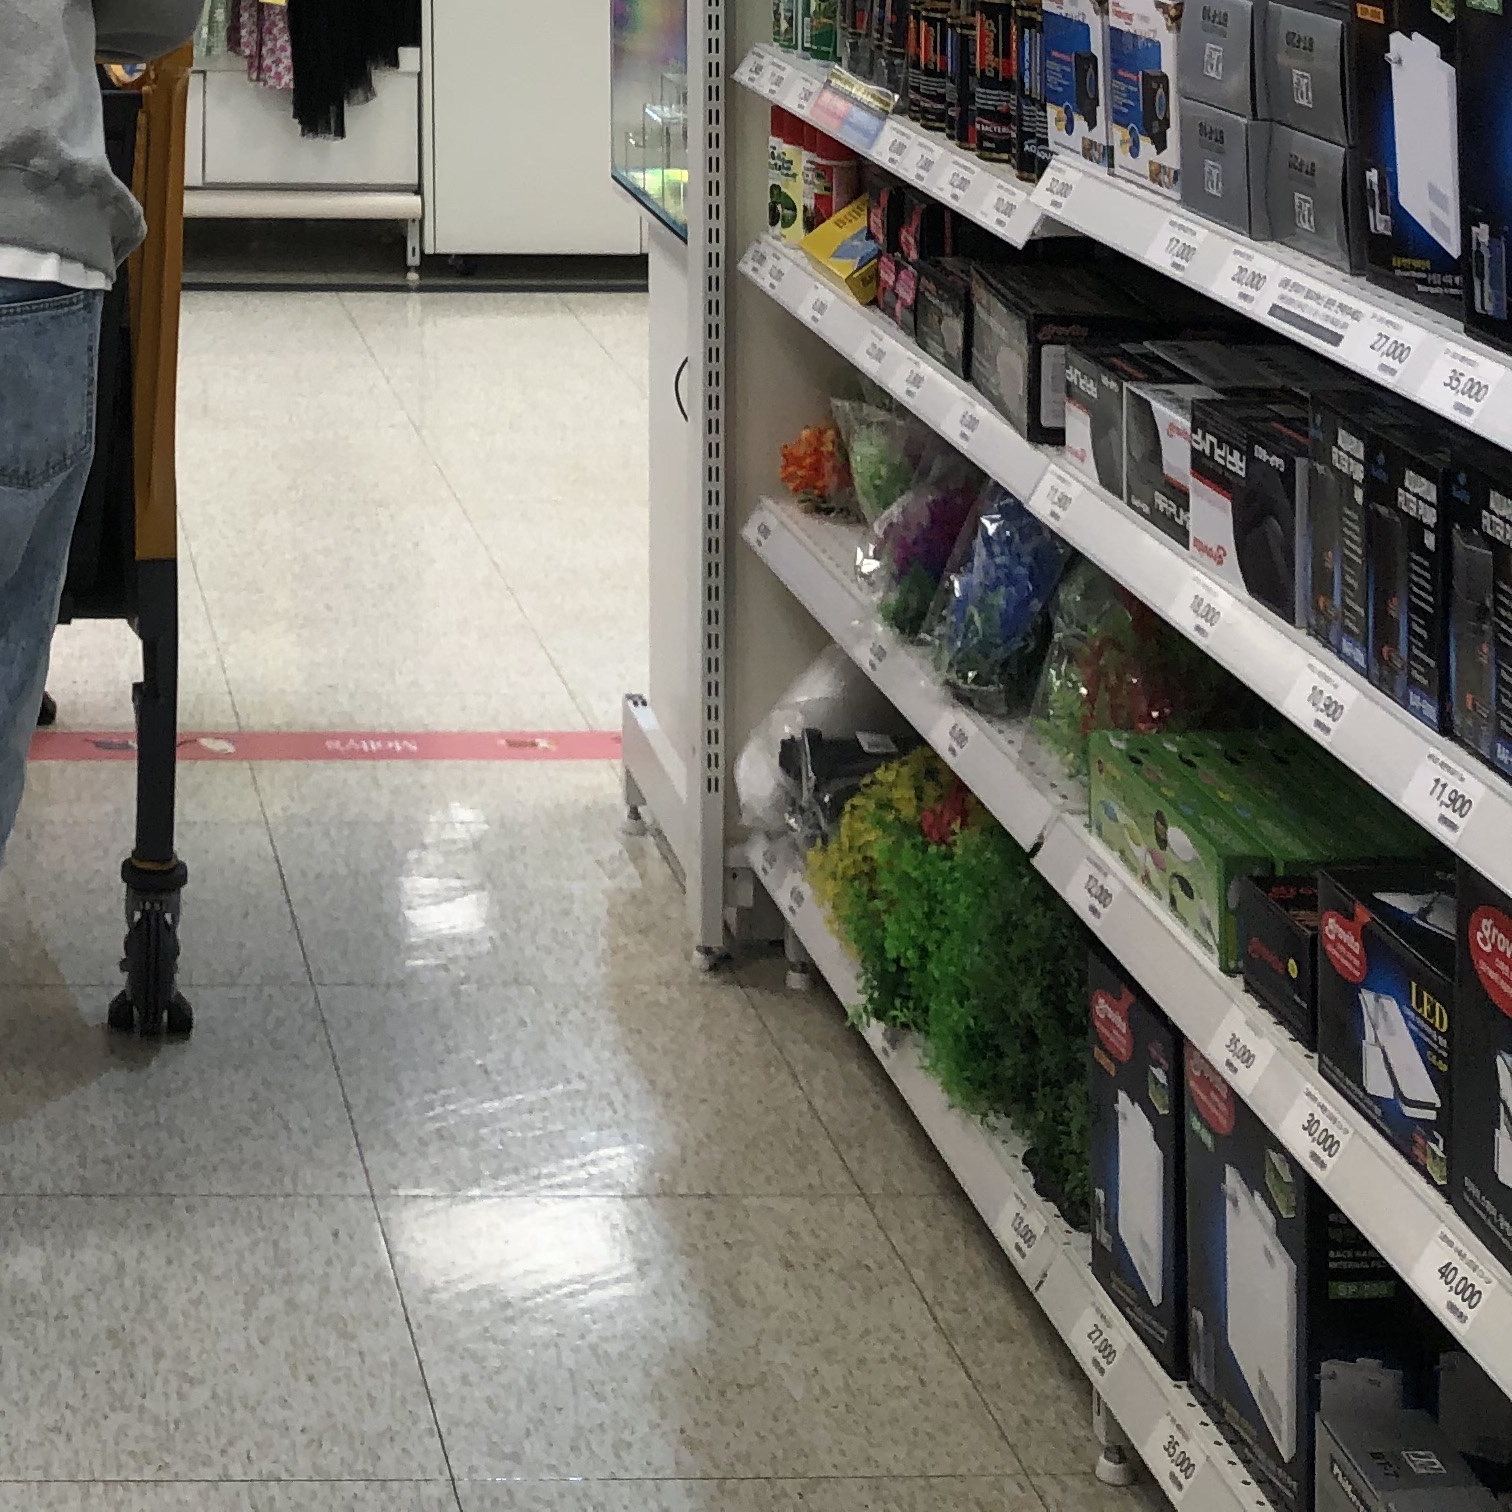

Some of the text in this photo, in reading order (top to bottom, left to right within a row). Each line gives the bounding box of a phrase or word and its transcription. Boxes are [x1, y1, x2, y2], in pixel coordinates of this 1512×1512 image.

[1165, 238, 1197, 263] 17,000
[1231, 266, 1267, 292] 20,000
[1370, 332, 1411, 365] 27,000
[1443, 369, 1489, 404] 35,000
[1429, 777, 1473, 819] 11,900
[1411, 980, 1449, 1033] LED
[1225, 1033, 1256, 1069] 35,000
[1302, 1112, 1341, 1159] 30,000
[1438, 1261, 1482, 1310] 40,000
[1087, 1323, 1116, 1366] 27,000
[1163, 1435, 1195, 1480] 35,000
